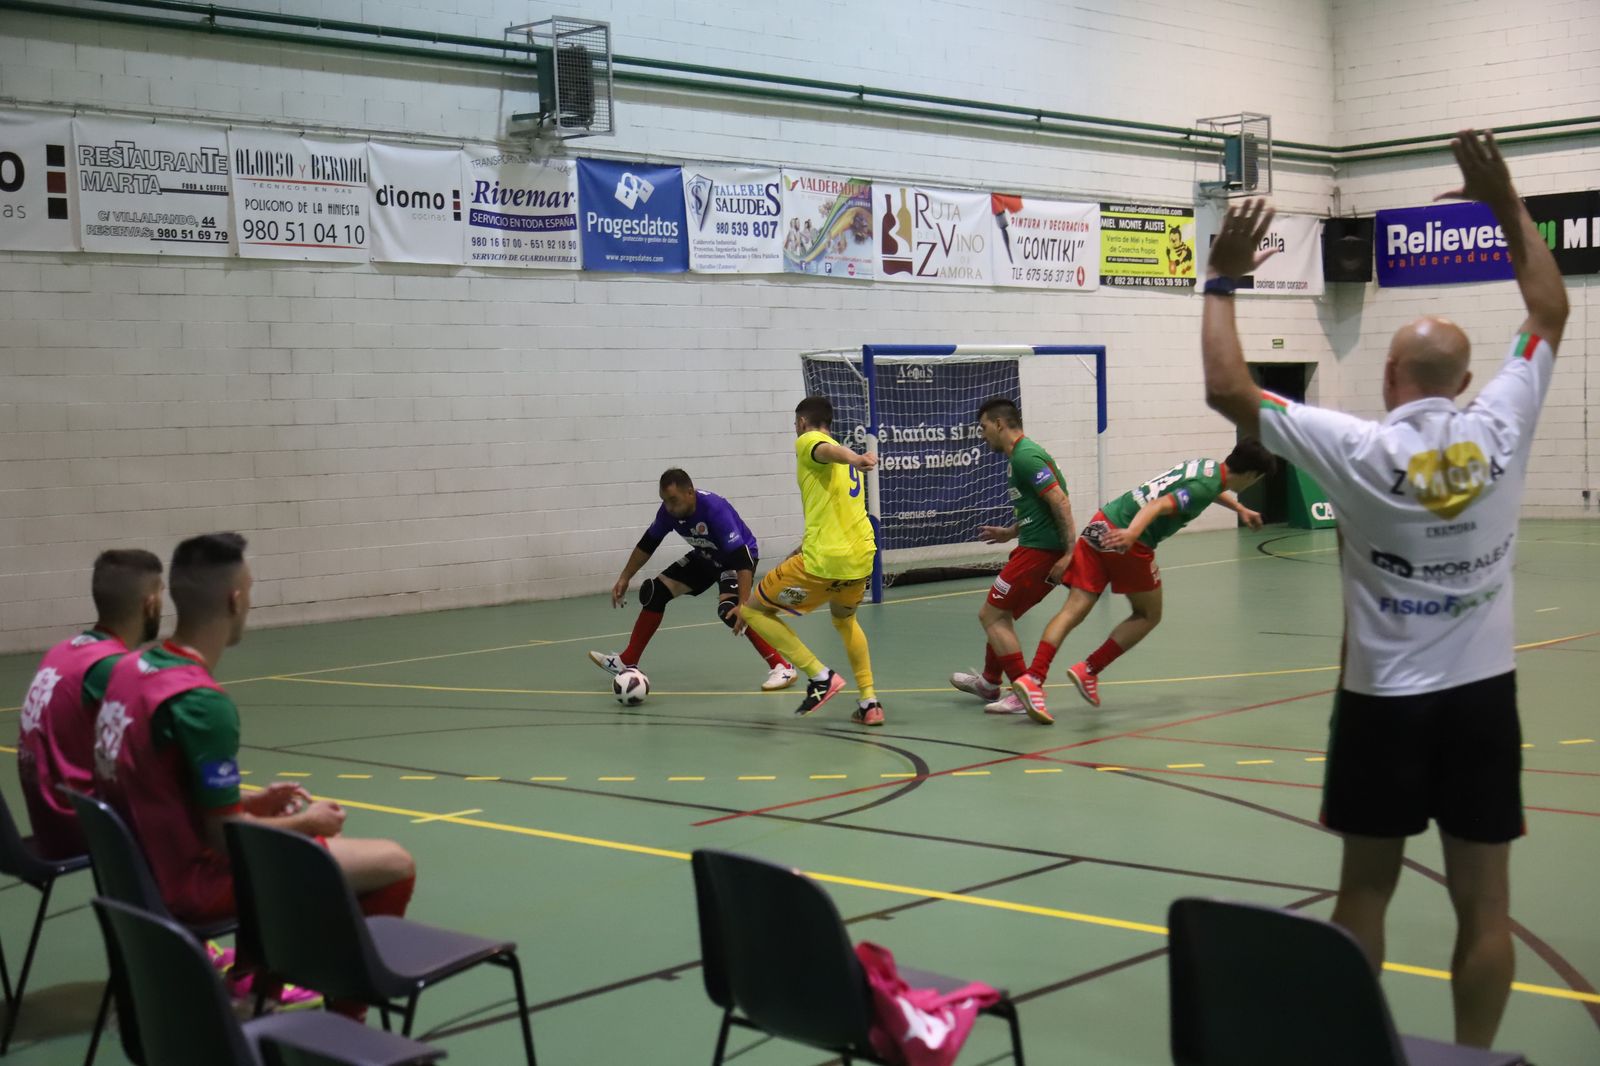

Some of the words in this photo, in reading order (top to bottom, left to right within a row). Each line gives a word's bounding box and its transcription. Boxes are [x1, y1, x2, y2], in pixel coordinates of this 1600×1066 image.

[78, 140, 229, 175] RESTAURANTE
[236, 148, 294, 178] ALONSO
[311, 154, 367, 183] BERNAL
[80, 170, 163, 195] MARTA
[182, 182, 197, 190] FOOD
[206, 184, 227, 192] COFFEE
[376, 185, 445, 210] diomo
[472, 180, 575, 208] Rivemar
[98, 210, 111, 222] C/
[201, 216, 216, 226] 44
[298, 202, 308, 213] DE
[313, 202, 323, 214] LA
[327, 203, 360, 216] HINIESTA
[412, 212, 447, 222] cocinas
[914, 193, 961, 230] RUTA
[472, 212, 509, 227] SERVICIO
[510, 218, 520, 228] EN
[522, 218, 544, 229] TODA
[545, 216, 575, 228] ESPAÑA
[587, 211, 679, 239] Progesdatos
[1012, 216, 1040, 229] PINTURA
[1043, 220, 1048, 230] Y
[1050, 219, 1089, 232] DECORACION
[1100, 218, 1116, 228] MIEL
[1119, 219, 1142, 230] MONTE
[1145, 221, 1164, 231] ALISTE
[157, 228, 178, 239] 980
[181, 229, 194, 239] 51
[198, 230, 212, 240] 69
[215, 231, 229, 241] 79
[243, 219, 279, 241] 980
[285, 222, 305, 242] 51
[314, 223, 338, 243] 04
[344, 224, 365, 245] 10
[716, 222, 729, 235] 980
[731, 222, 749, 237] 539
[753, 221, 779, 239] 807
[1387, 221, 1509, 255] Relieves
[471, 236, 487, 247] 980
[490, 238, 500, 248] 16
[502, 238, 511, 248] 67
[513, 239, 522, 248] 00
[530, 239, 544, 249] 651
[547, 240, 556, 249] 92
[558, 240, 566, 250] 18
[568, 241, 577, 250] 90
[936, 223, 984, 258] VINO
[472, 253, 508, 261] SERVICIO
[605, 254, 664, 263] www.progesdatos.com
[916, 242, 983, 279] ZAMORA
[1026, 268, 1041, 281] 675
[1042, 268, 1053, 282] 56
[1056, 270, 1065, 282] 37
[1066, 270, 1075, 283] 37
[1256, 280, 1276, 289] cocinas
[1276, 281, 1286, 289] con
[843, 423, 887, 447] ¿Qé
[891, 422, 946, 443] harías
[950, 423, 965, 441] si
[925, 447, 981, 469] miedo?
